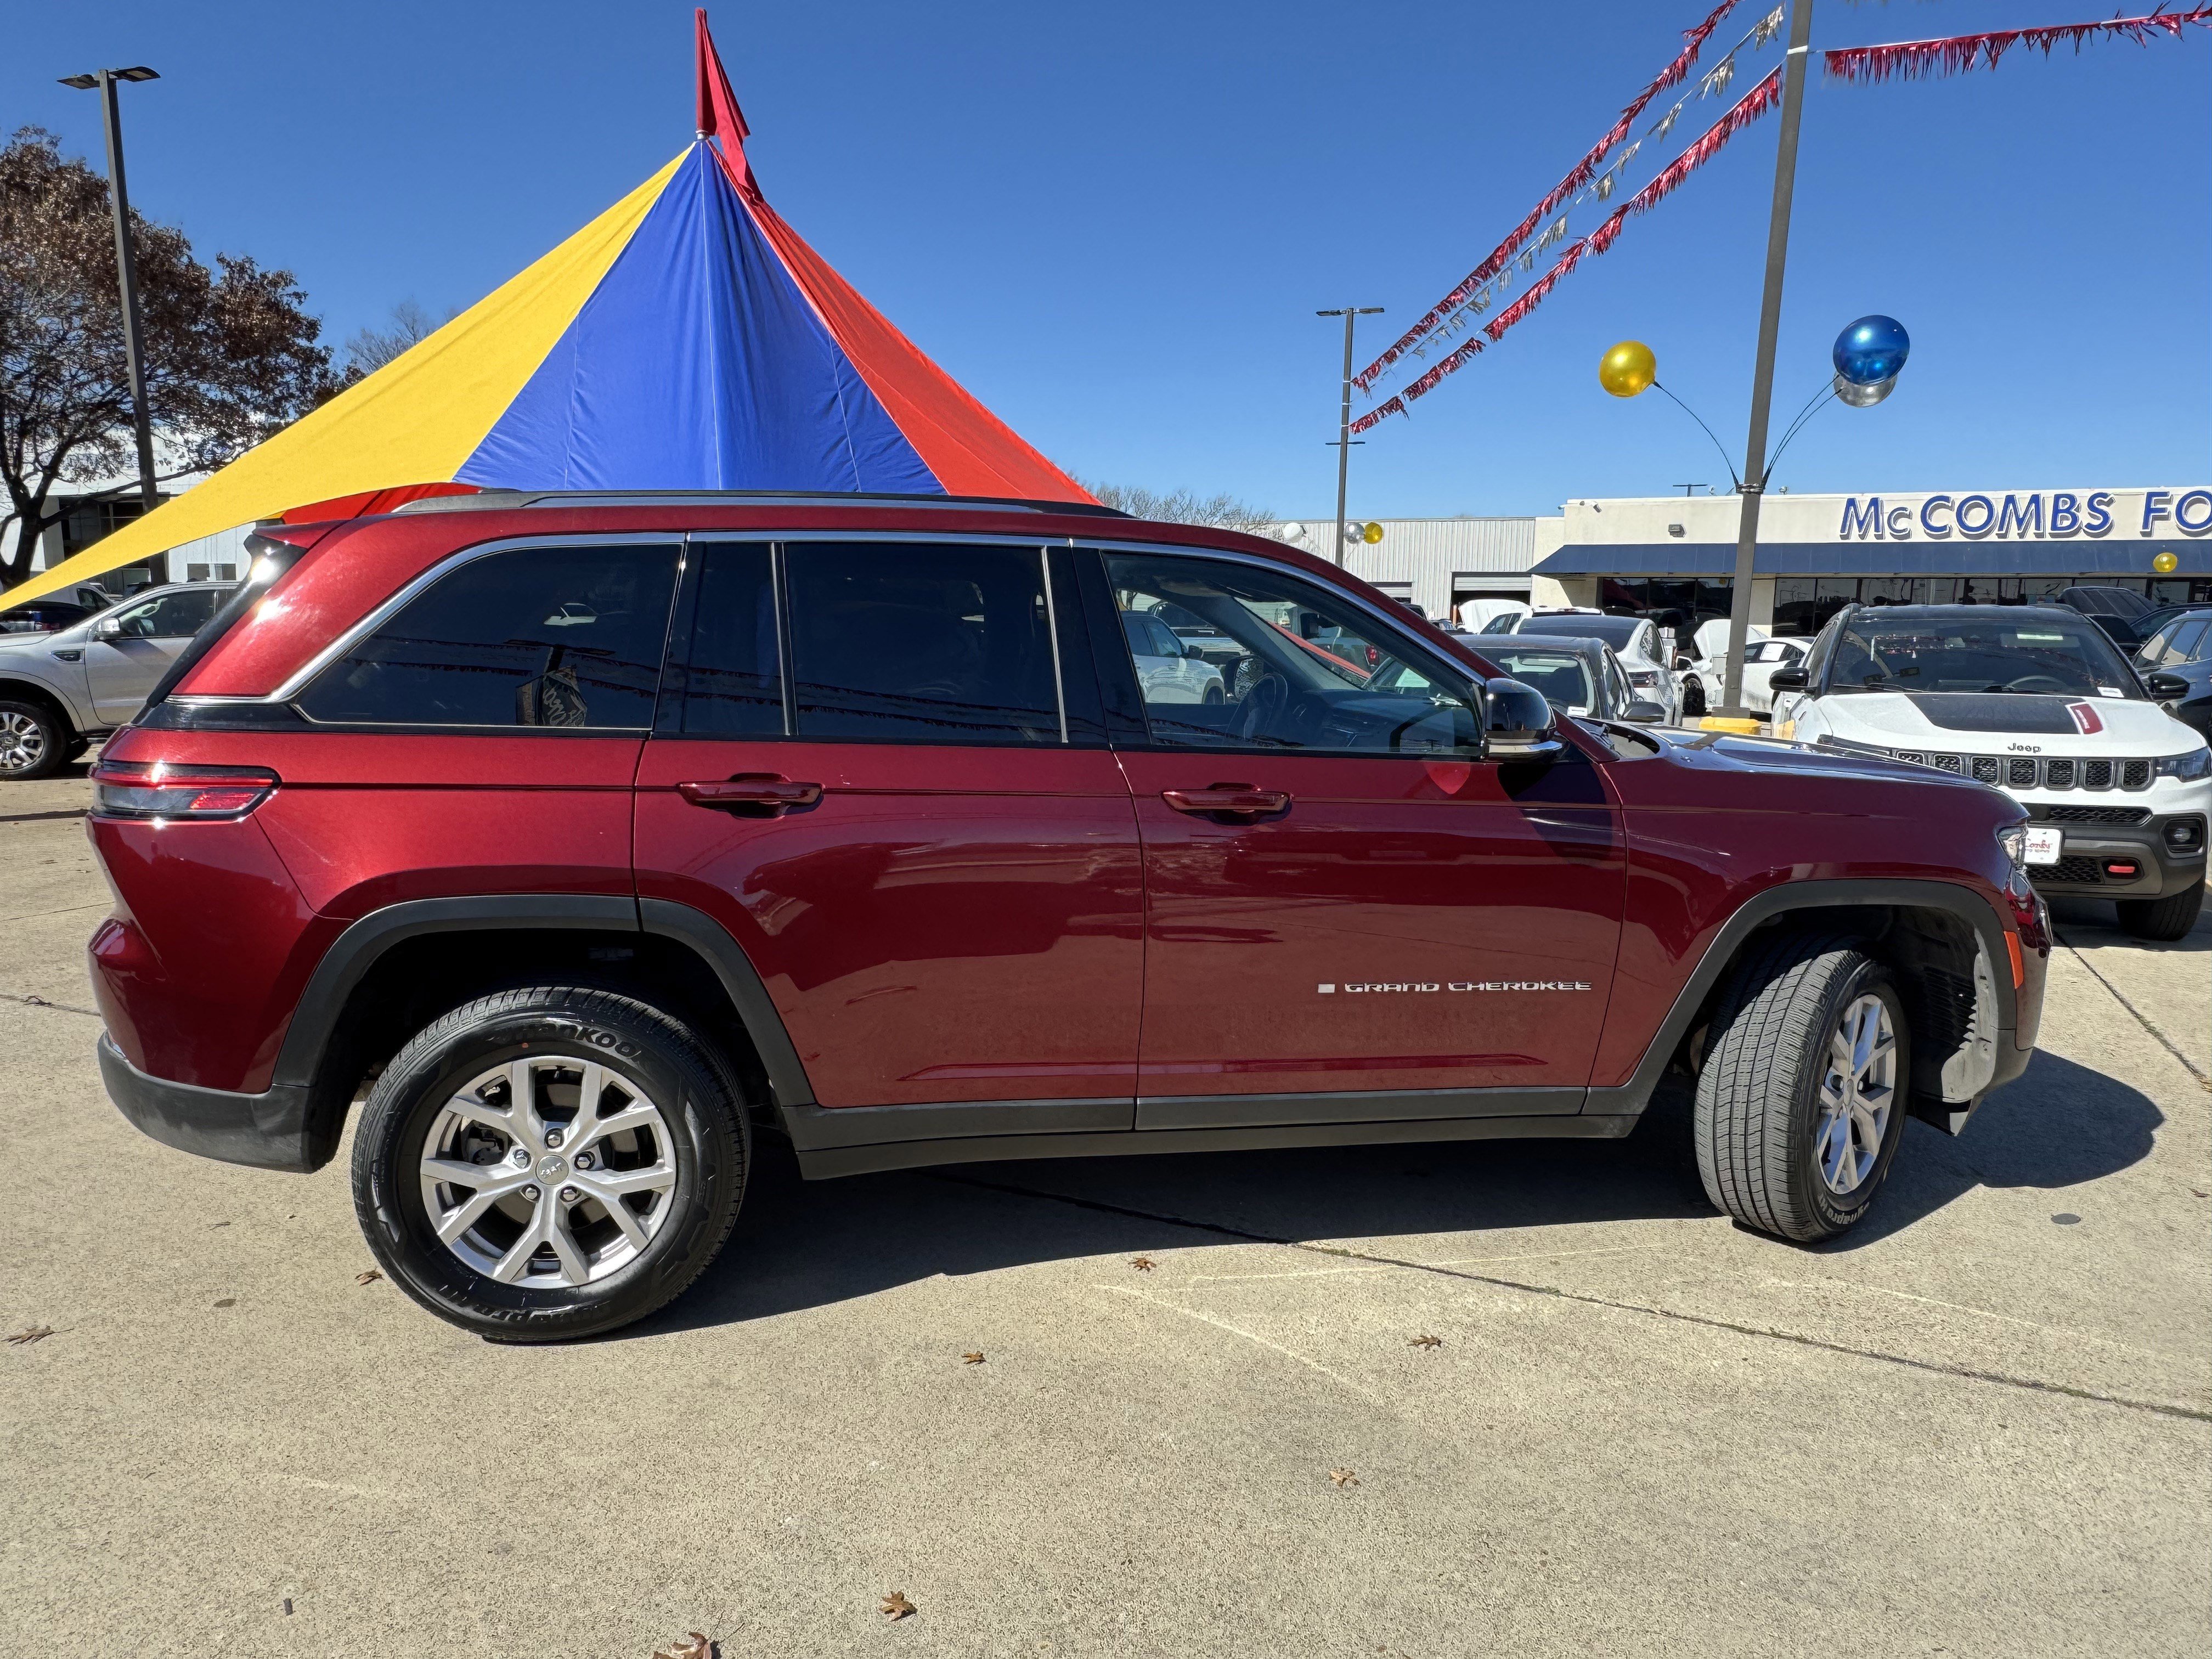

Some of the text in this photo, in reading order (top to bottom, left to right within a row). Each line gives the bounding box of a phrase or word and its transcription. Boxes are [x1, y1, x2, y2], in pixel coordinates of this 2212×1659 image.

[1840, 493, 2115, 535] McCOMBS
[2007, 742, 2041, 753] Jeep
[1345, 981, 1592, 993] GRAND CHEROKEE
